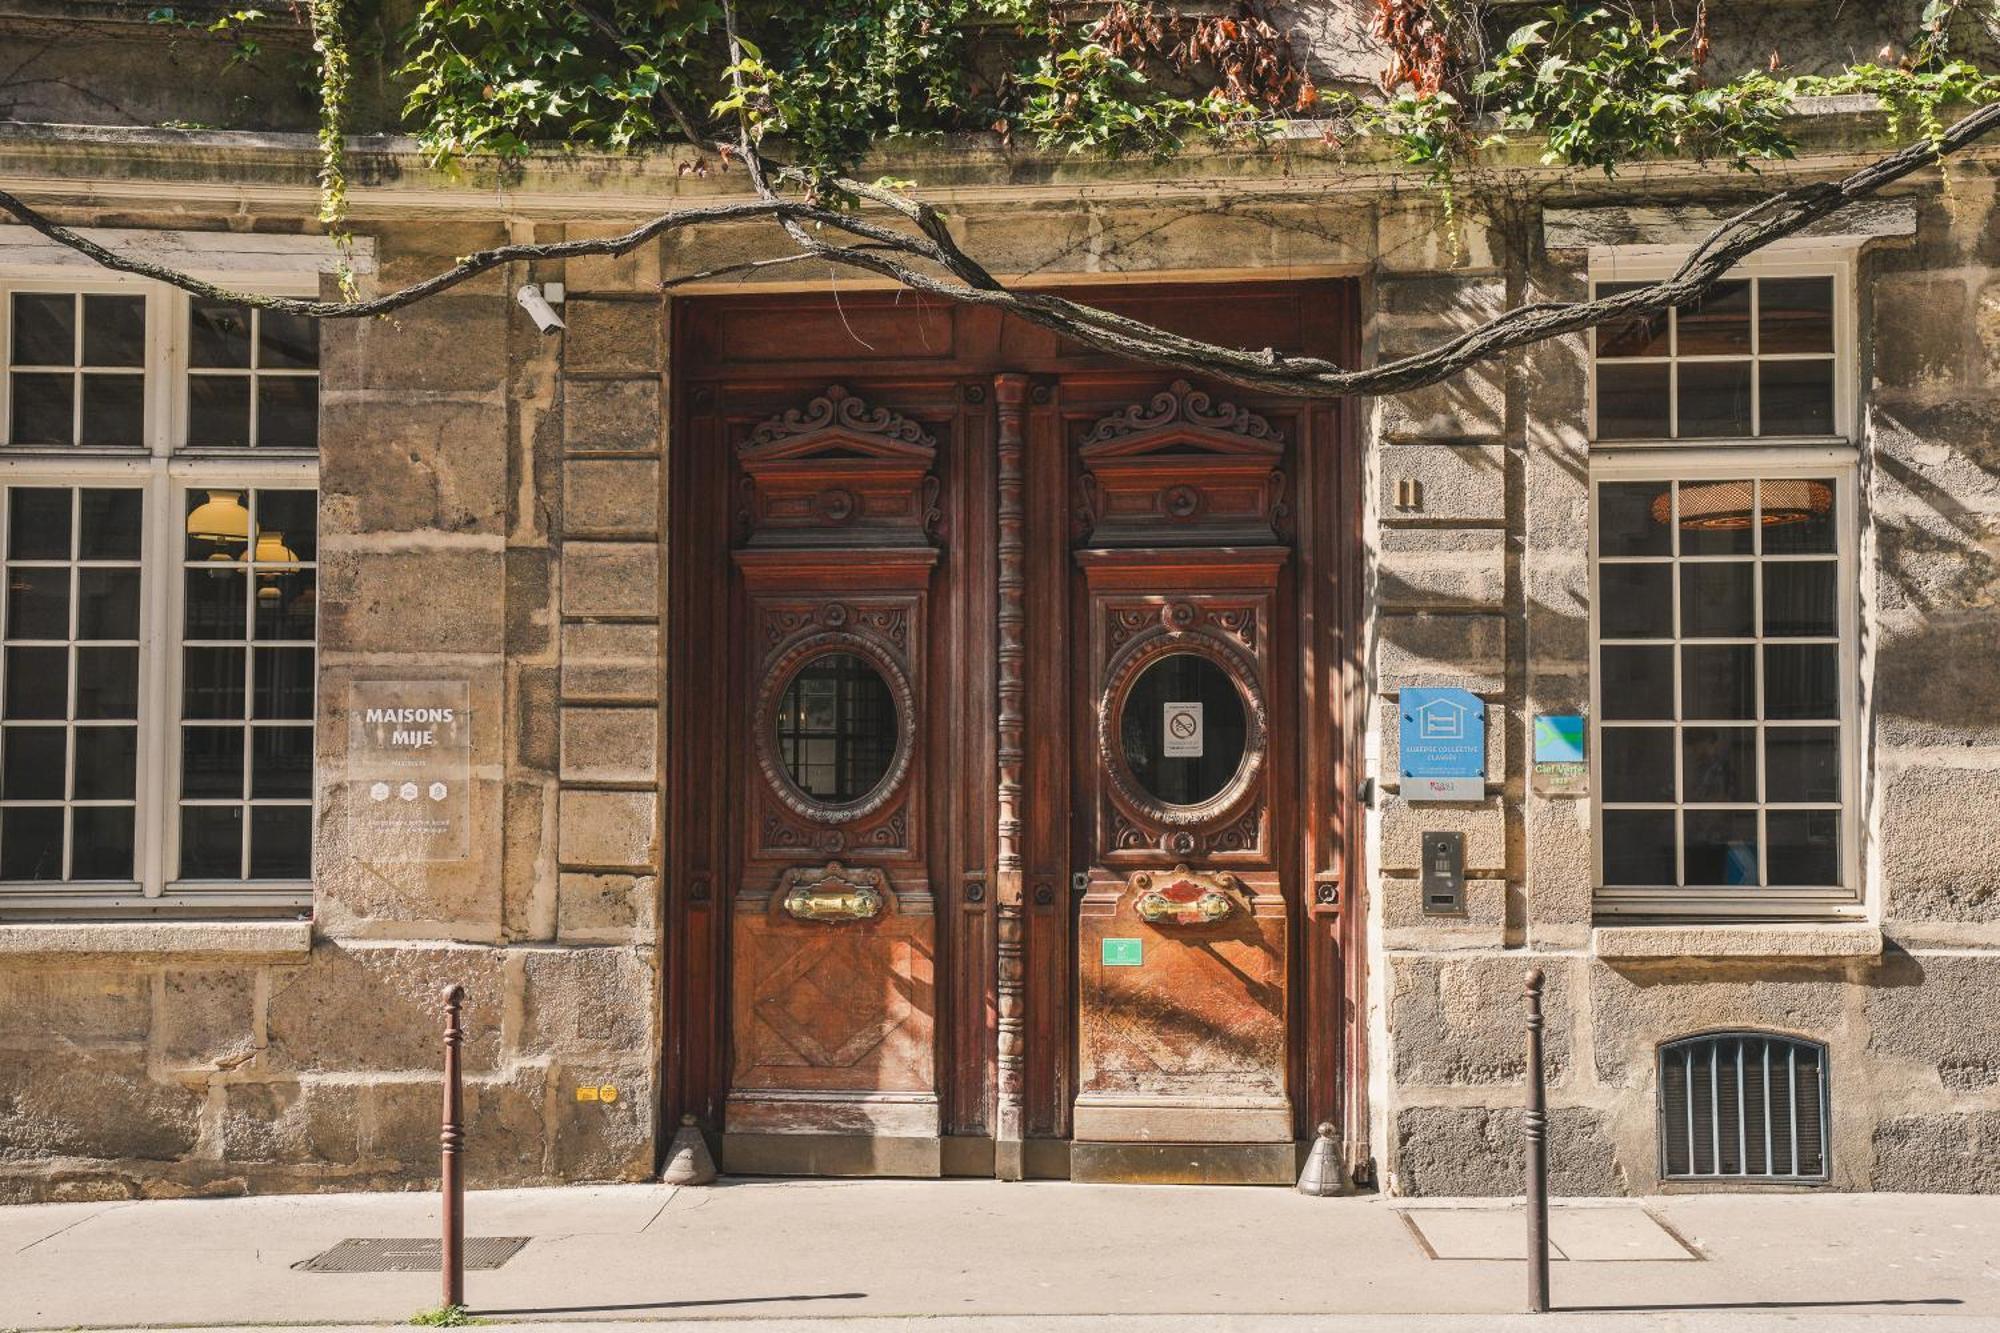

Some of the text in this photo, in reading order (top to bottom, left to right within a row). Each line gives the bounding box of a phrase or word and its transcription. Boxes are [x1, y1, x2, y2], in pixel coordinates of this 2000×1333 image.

[366, 708, 454, 723] MAISONS
[392, 730, 433, 749] MIJE
[1439, 745, 1478, 753] COLLECTIVE
